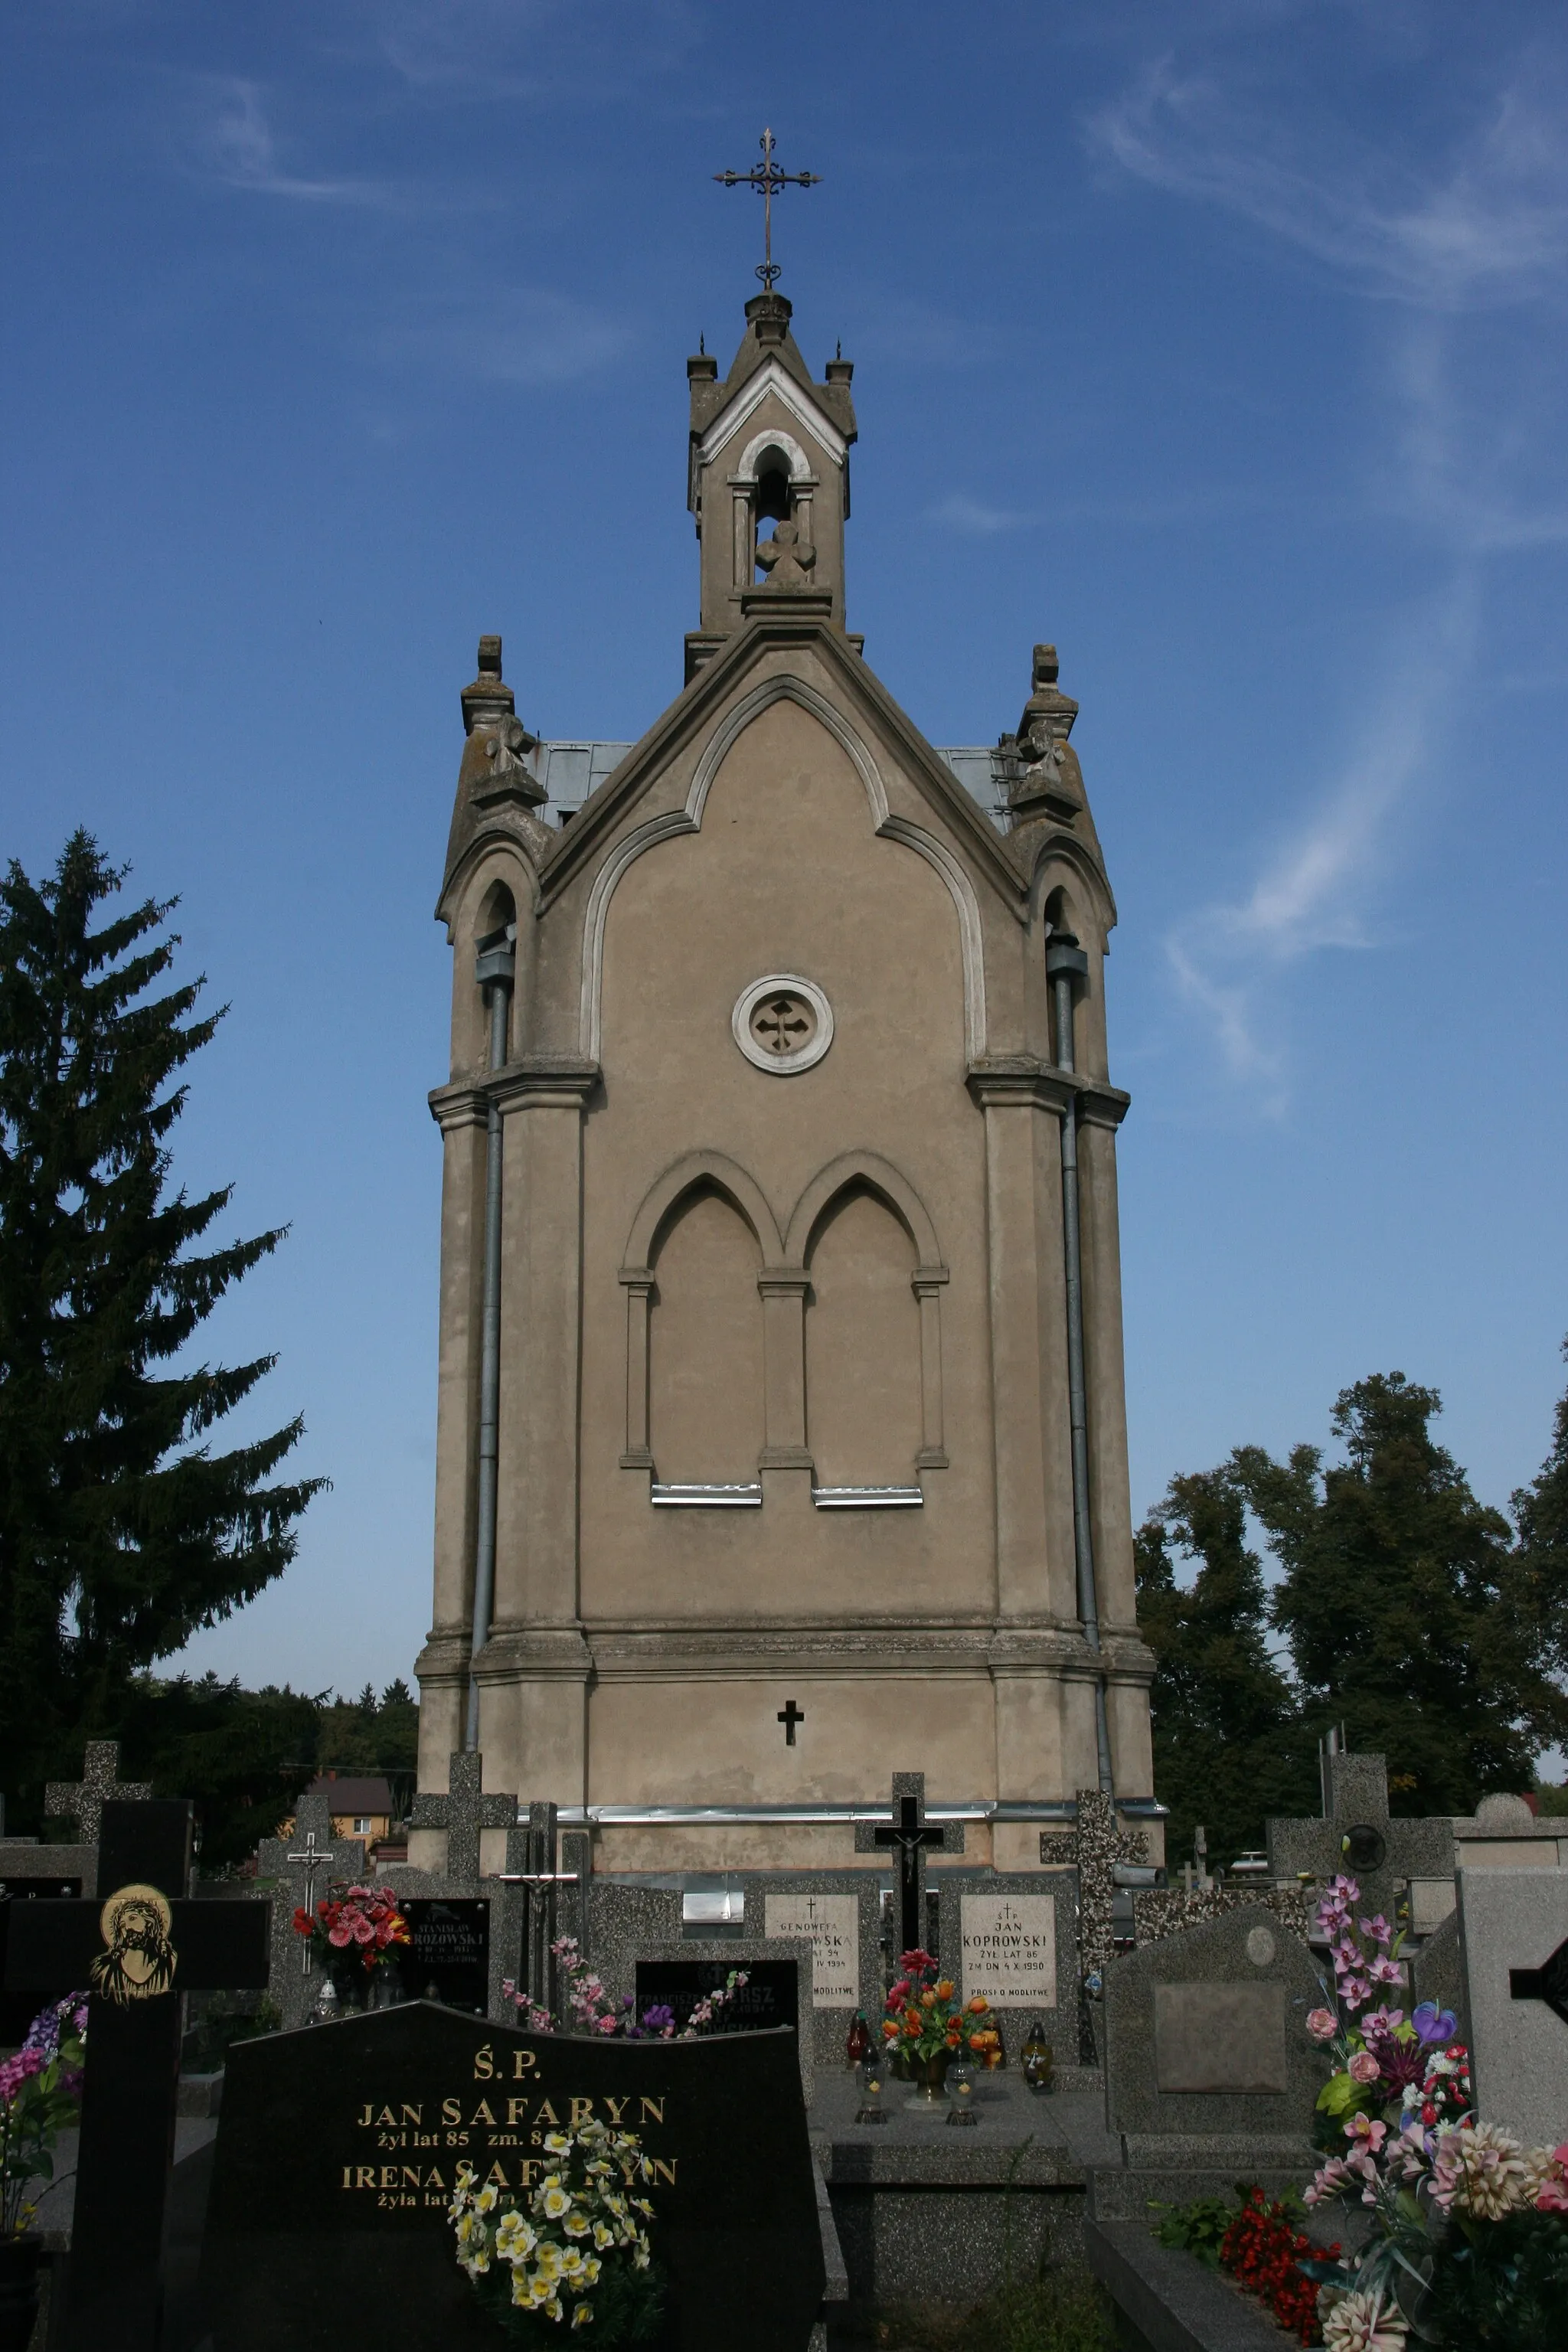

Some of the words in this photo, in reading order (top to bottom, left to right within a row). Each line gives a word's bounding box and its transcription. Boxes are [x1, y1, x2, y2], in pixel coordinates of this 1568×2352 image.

[780, 1922, 838, 1931] GENOWEFA
[995, 1922, 1022, 1932] JAN
[963, 1936, 1046, 1947] KOPROWSKI
[828, 1949, 838, 1957] 94
[1004, 1950, 1021, 1958] LAT
[1027, 1950, 1038, 1958] 86
[969, 1962, 982, 1971] ZM
[1013, 1962, 1019, 1971] X
[474, 2043, 501, 2080] Ś.
[513, 2050, 541, 2080] P.
[357, 2104, 423, 2127] JAN
[441, 2096, 666, 2126] SAFARYN
[377, 2131, 407, 2151] żył
[413, 2131, 439, 2147] lat
[446, 2131, 469, 2147] 85
[487, 2134, 524, 2147] zm.
[530, 2130, 542, 2146] 8
[341, 2165, 446, 2189] IRENA
[454, 2158, 678, 2187] SAFYN
[377, 2192, 416, 2210] żyła
[423, 2192, 448, 2207] lat
